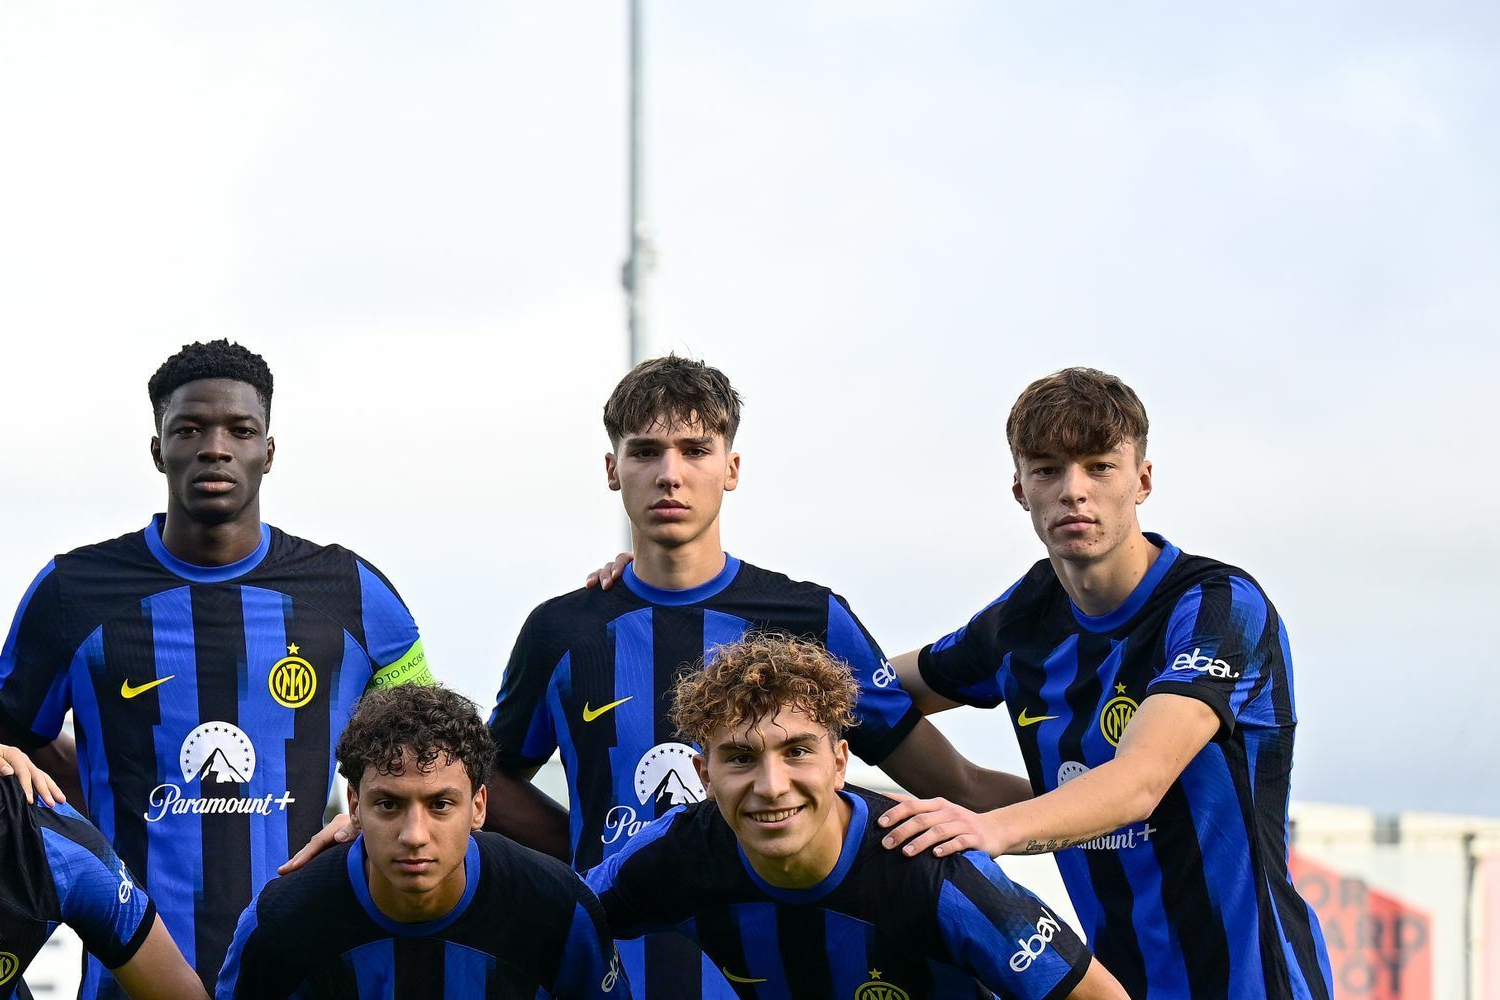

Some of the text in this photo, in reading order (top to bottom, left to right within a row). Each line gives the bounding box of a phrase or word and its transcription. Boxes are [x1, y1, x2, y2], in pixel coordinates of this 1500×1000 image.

[872, 658, 897, 688] eb
[143, 783, 296, 823] Paramount+
[1009, 906, 1061, 972] ebay
